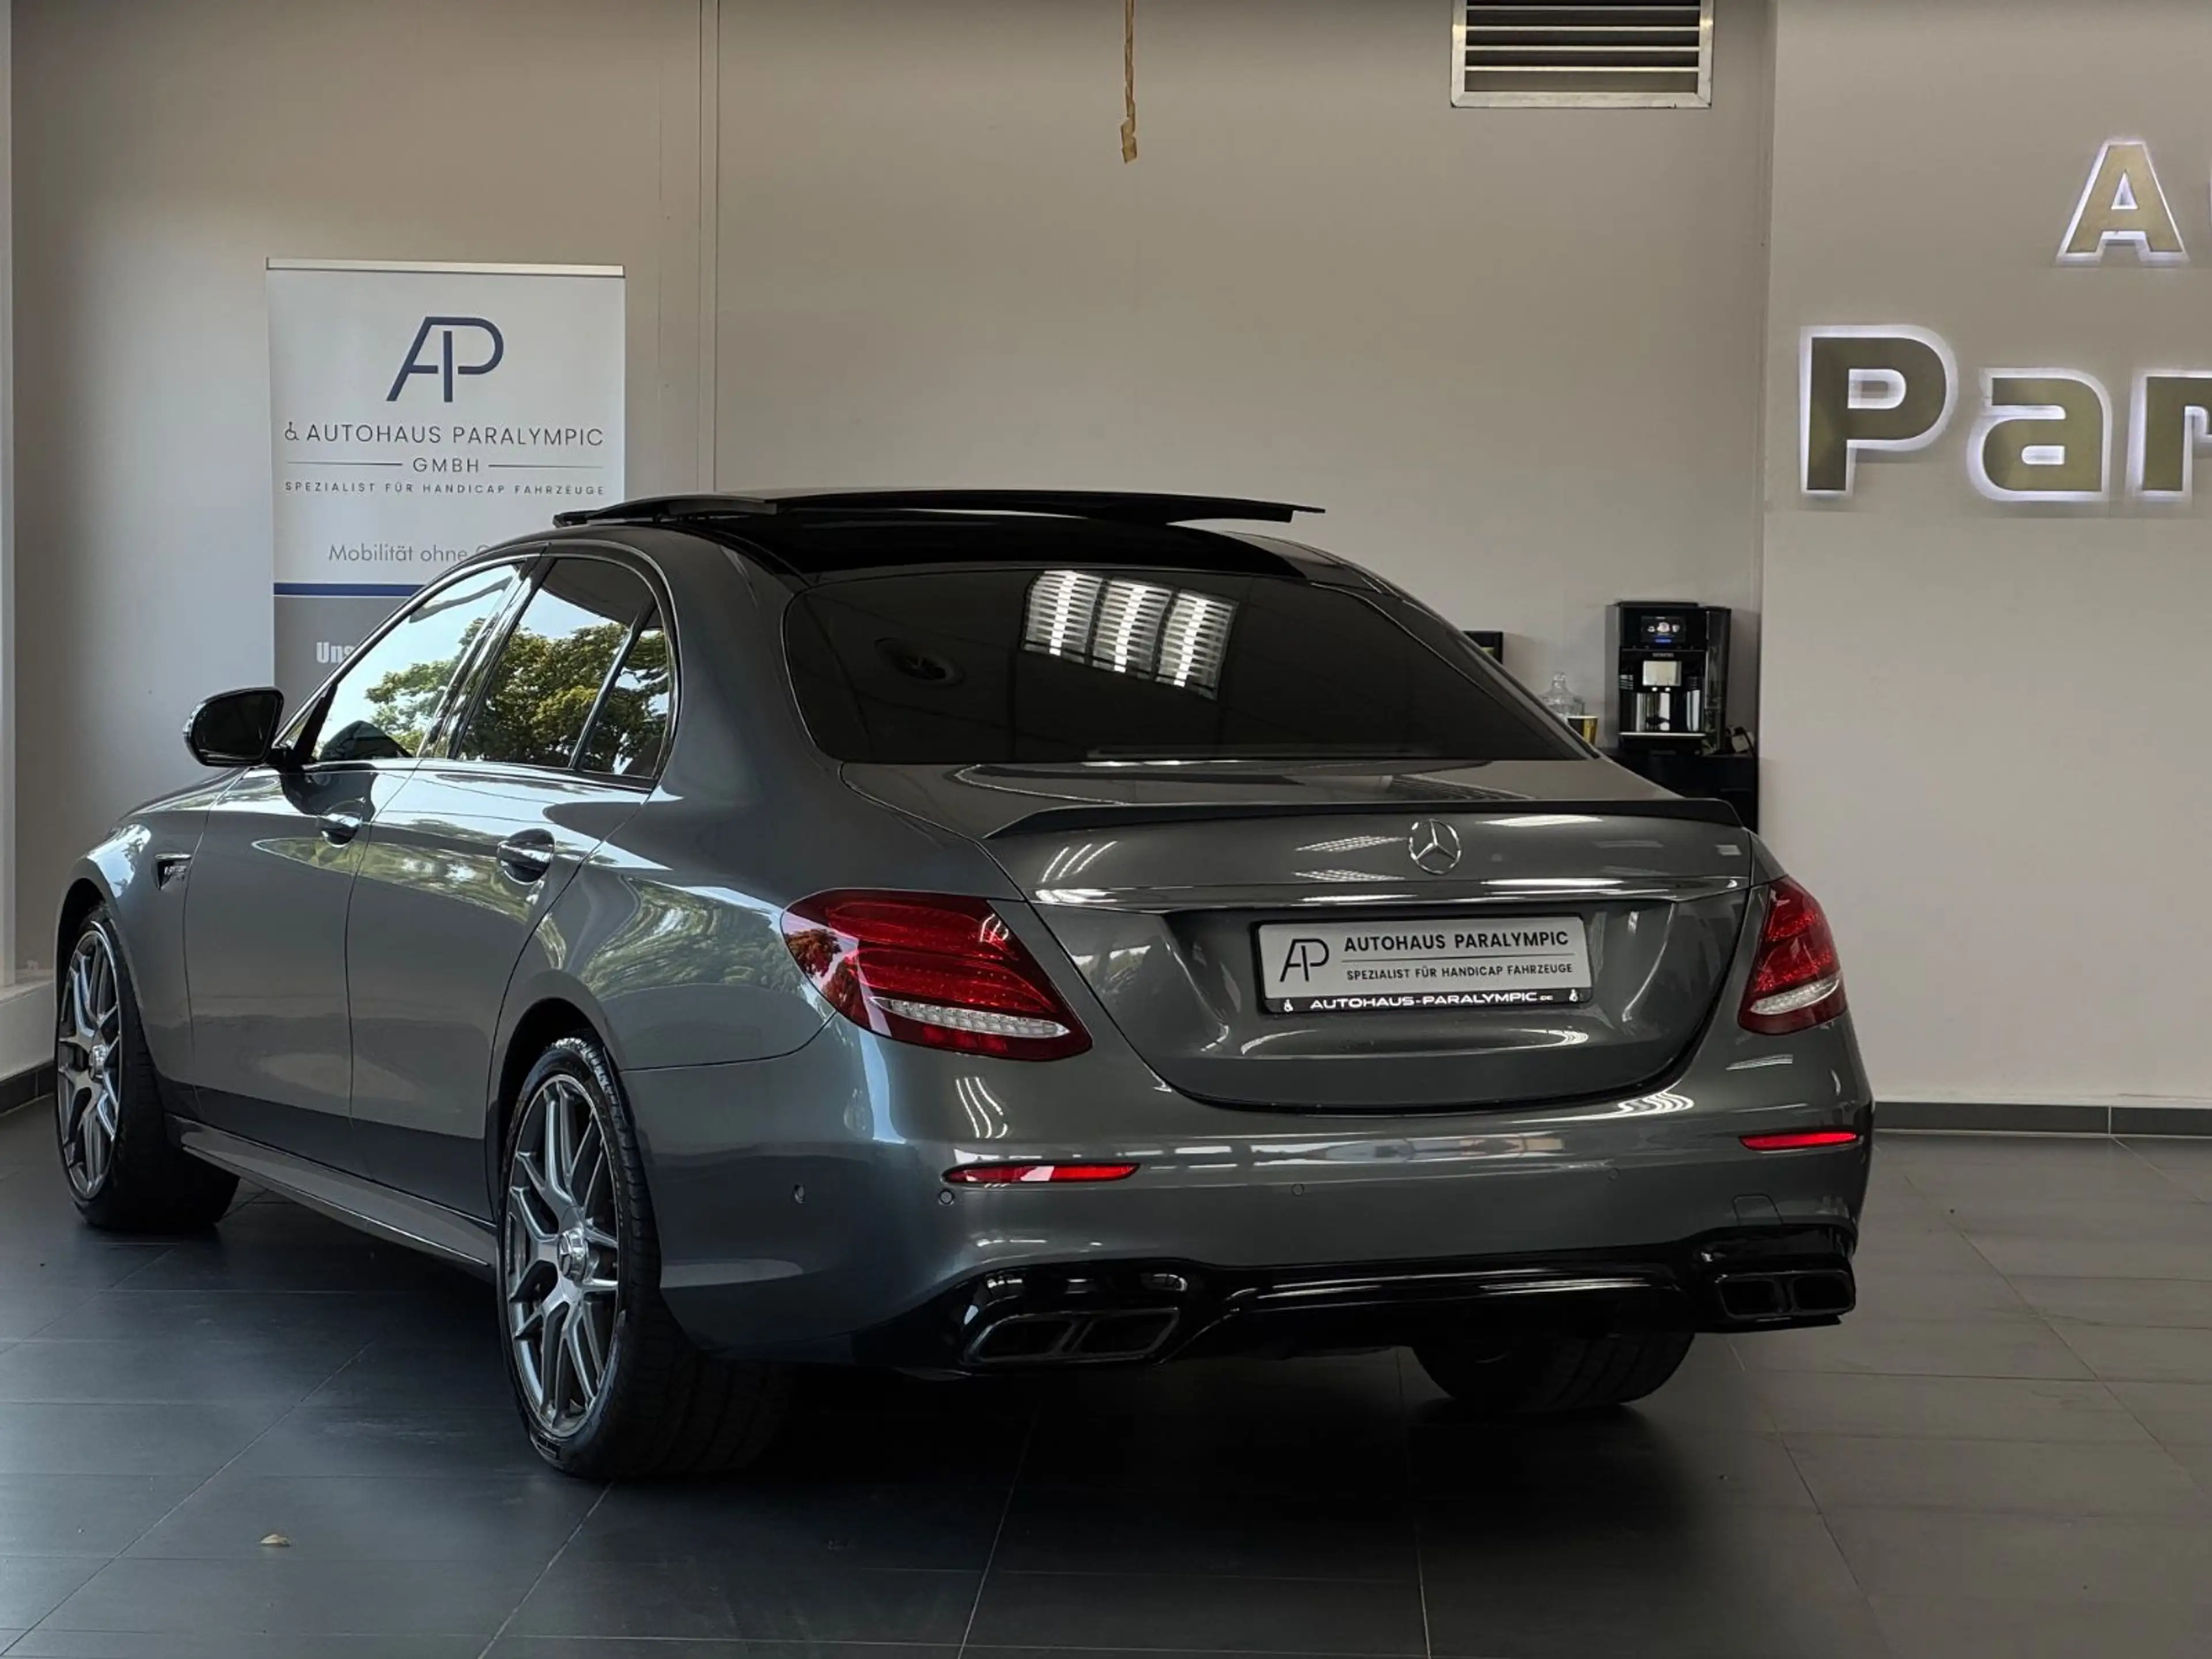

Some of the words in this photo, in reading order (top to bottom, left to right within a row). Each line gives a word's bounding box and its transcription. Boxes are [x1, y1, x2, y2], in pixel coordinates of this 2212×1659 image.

[2056, 141, 2212, 263] A
[386, 316, 505, 403] AP
[306, 423, 442, 443] AUTOHAUS
[453, 426, 604, 446] PARALYMPIC
[412, 457, 479, 473] GMBH
[285, 482, 376, 493] SPEZIALIST
[385, 482, 414, 493] FÜR
[423, 484, 505, 494] HANDICAP
[514, 485, 604, 495] FAHRZEUGE
[328, 543, 413, 562] Mobilität
[419, 544, 468, 562] ohne
[1344, 934, 1446, 952] AUTOHAUS
[1454, 931, 1569, 949] PARALYMPIC
[1279, 938, 1330, 982] AP
[1346, 969, 1410, 980] SPEZIALIST
[1415, 965, 1437, 978] FÜR
[1441, 966, 1503, 978] HANDICAP
[1507, 963, 1573, 976] FAHRZEUGE
